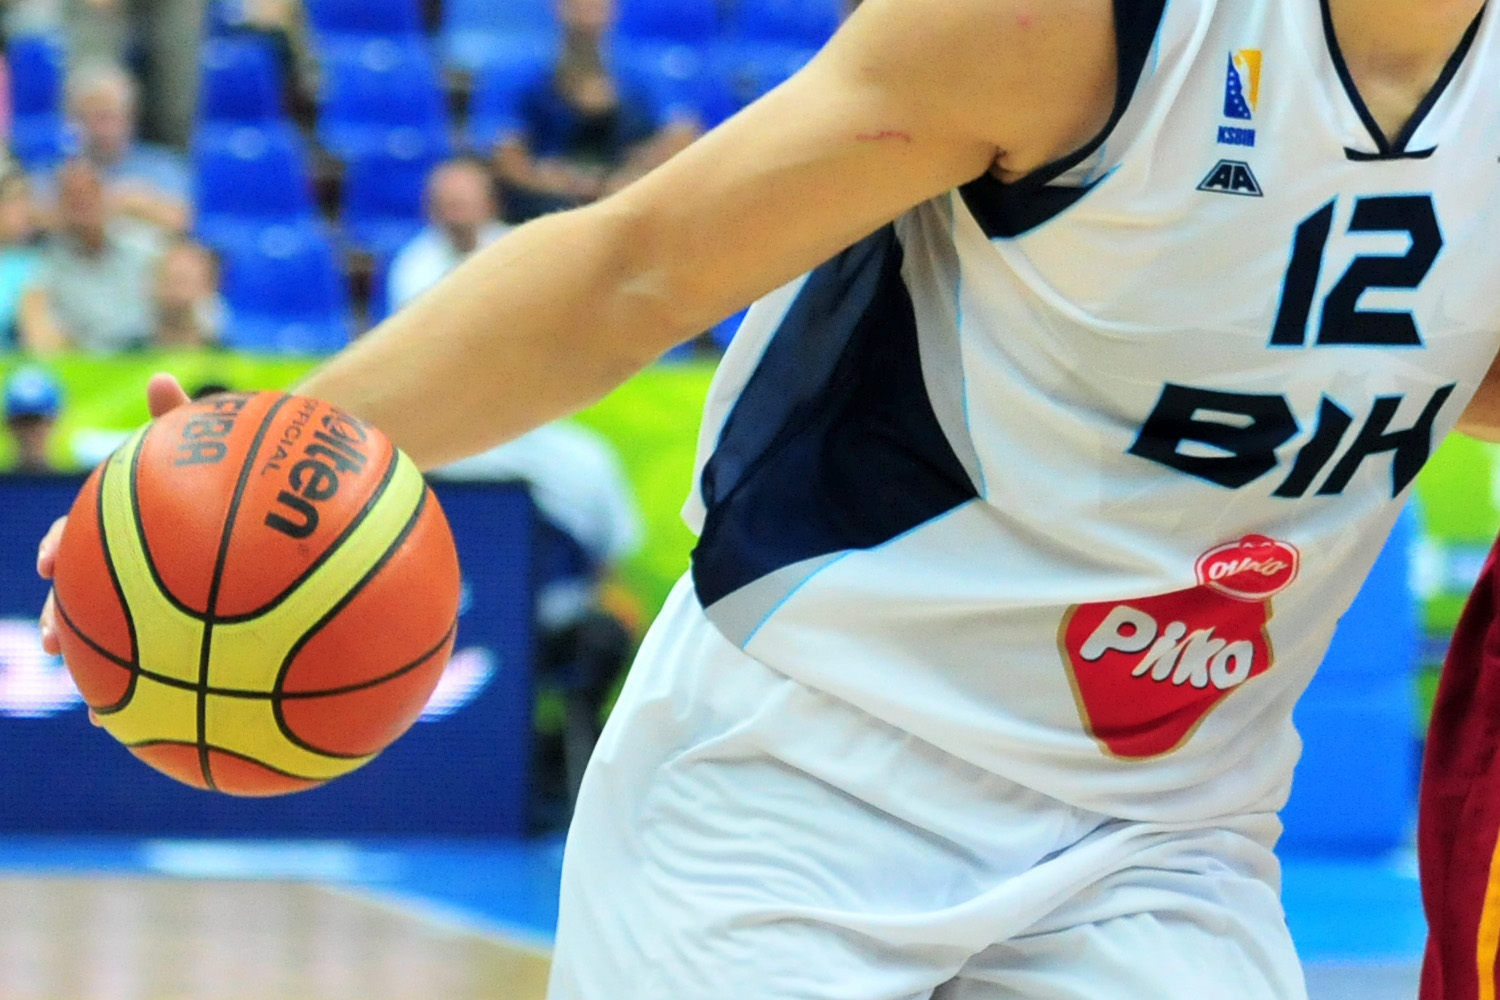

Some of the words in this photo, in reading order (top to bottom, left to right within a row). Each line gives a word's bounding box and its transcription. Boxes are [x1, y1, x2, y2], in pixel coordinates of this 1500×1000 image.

[1267, 194, 1445, 349] 12
[173, 398, 248, 467] FIBA
[264, 403, 369, 540] olten
[1126, 382, 1457, 499] BIH
